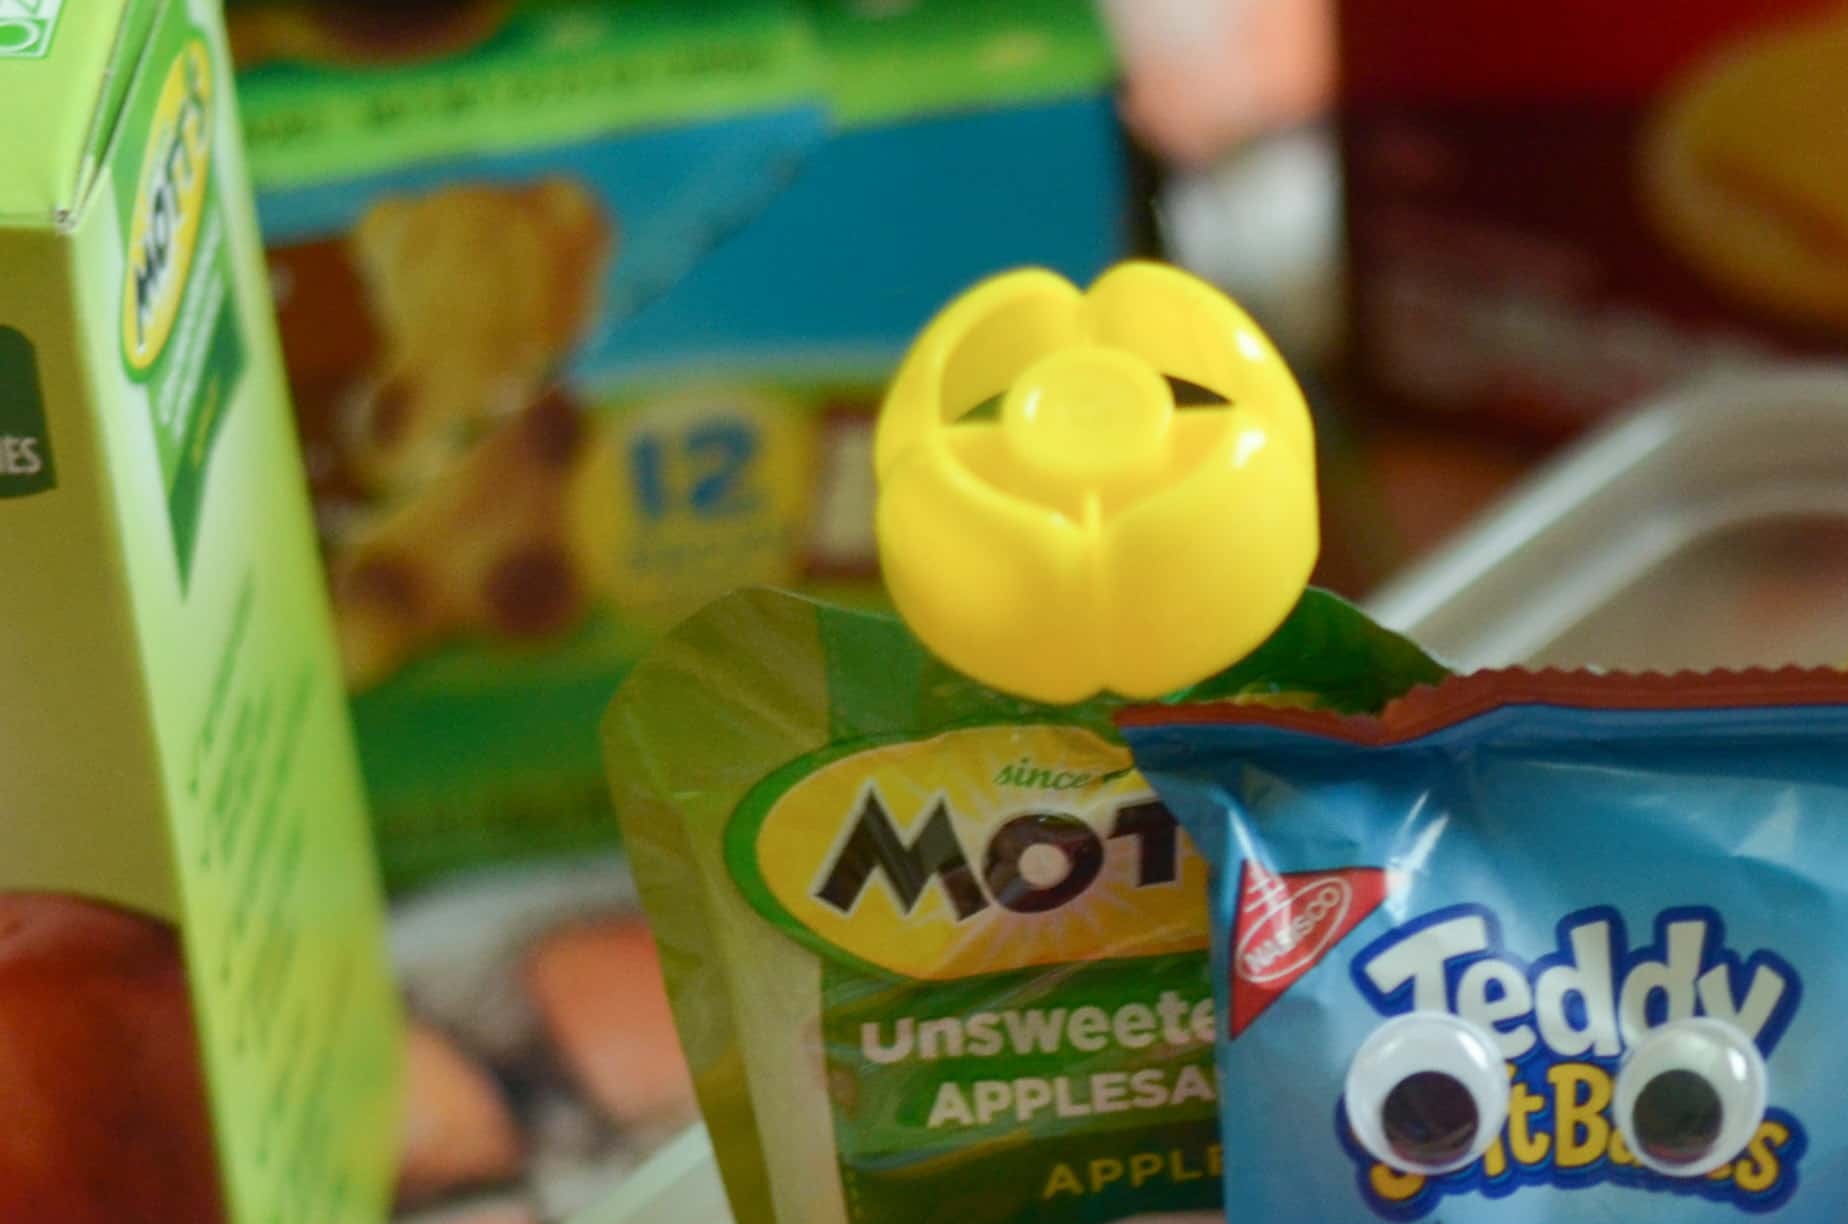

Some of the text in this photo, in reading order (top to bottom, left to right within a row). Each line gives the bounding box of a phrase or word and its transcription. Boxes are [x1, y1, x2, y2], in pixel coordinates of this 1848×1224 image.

[993, 758, 1090, 790] since
[814, 787, 1179, 922] MOT
[1365, 914, 1786, 1058] Teddy
[861, 990, 1215, 1064] Unsweete
[927, 1065, 1218, 1128] APPLESA
